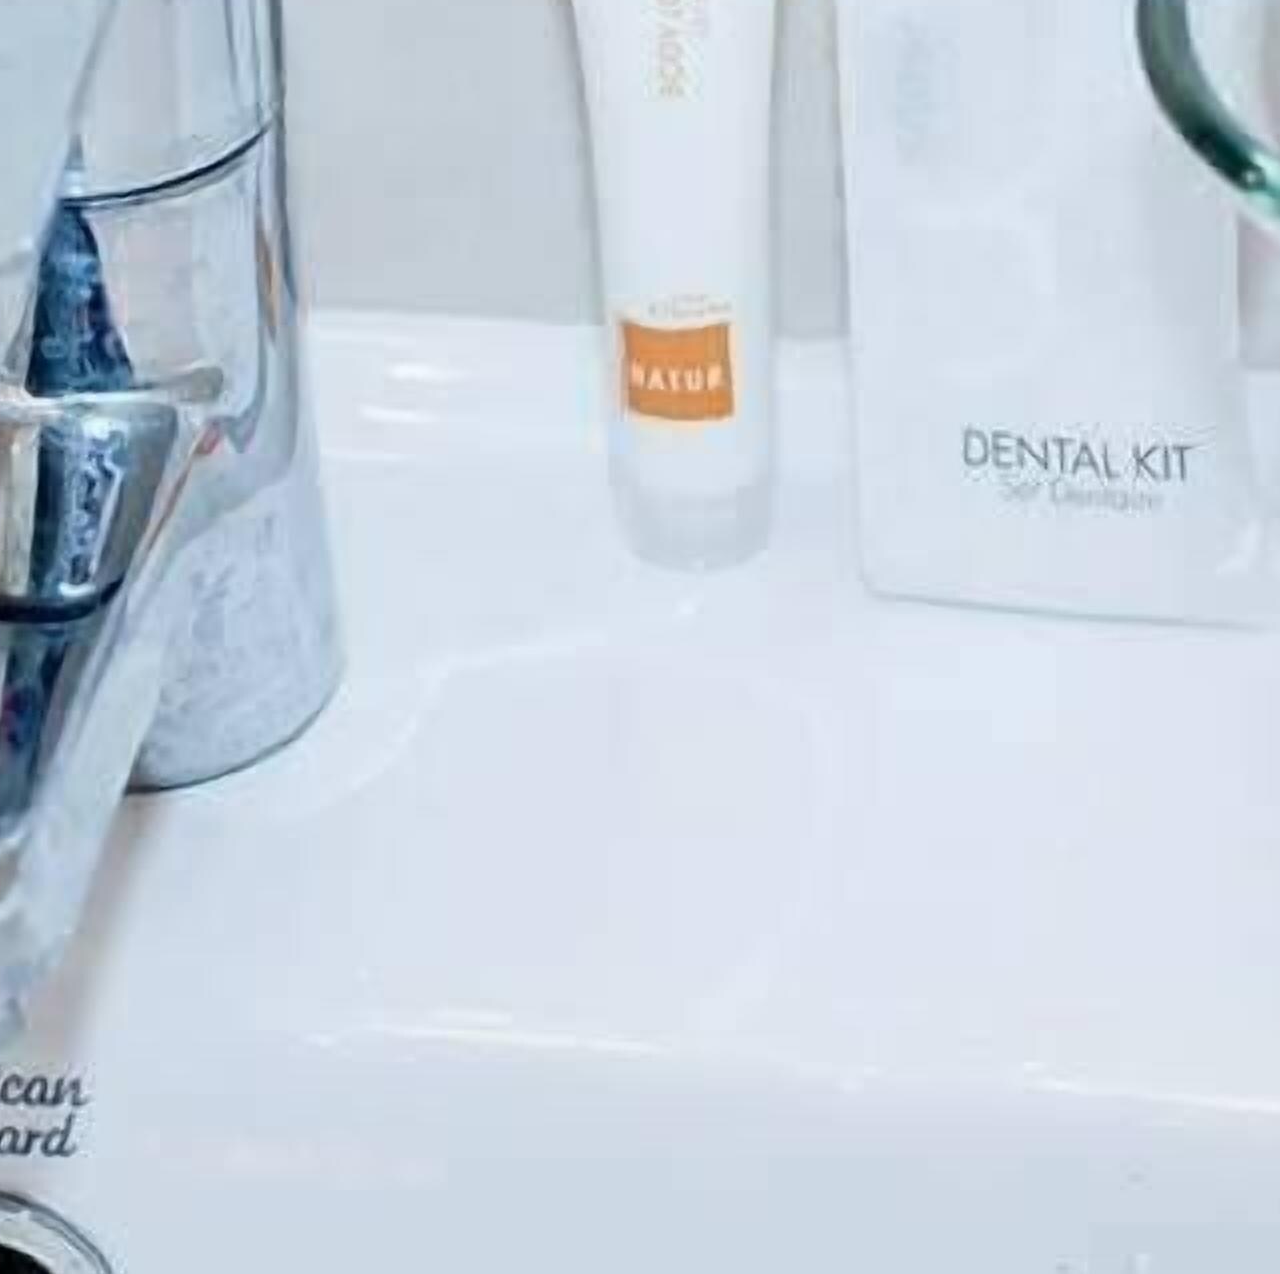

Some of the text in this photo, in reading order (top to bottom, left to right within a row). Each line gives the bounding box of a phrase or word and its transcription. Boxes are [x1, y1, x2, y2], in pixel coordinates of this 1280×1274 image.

[630, 358, 726, 391] NATUR
[962, 428, 1196, 483] DENTAL KIT
